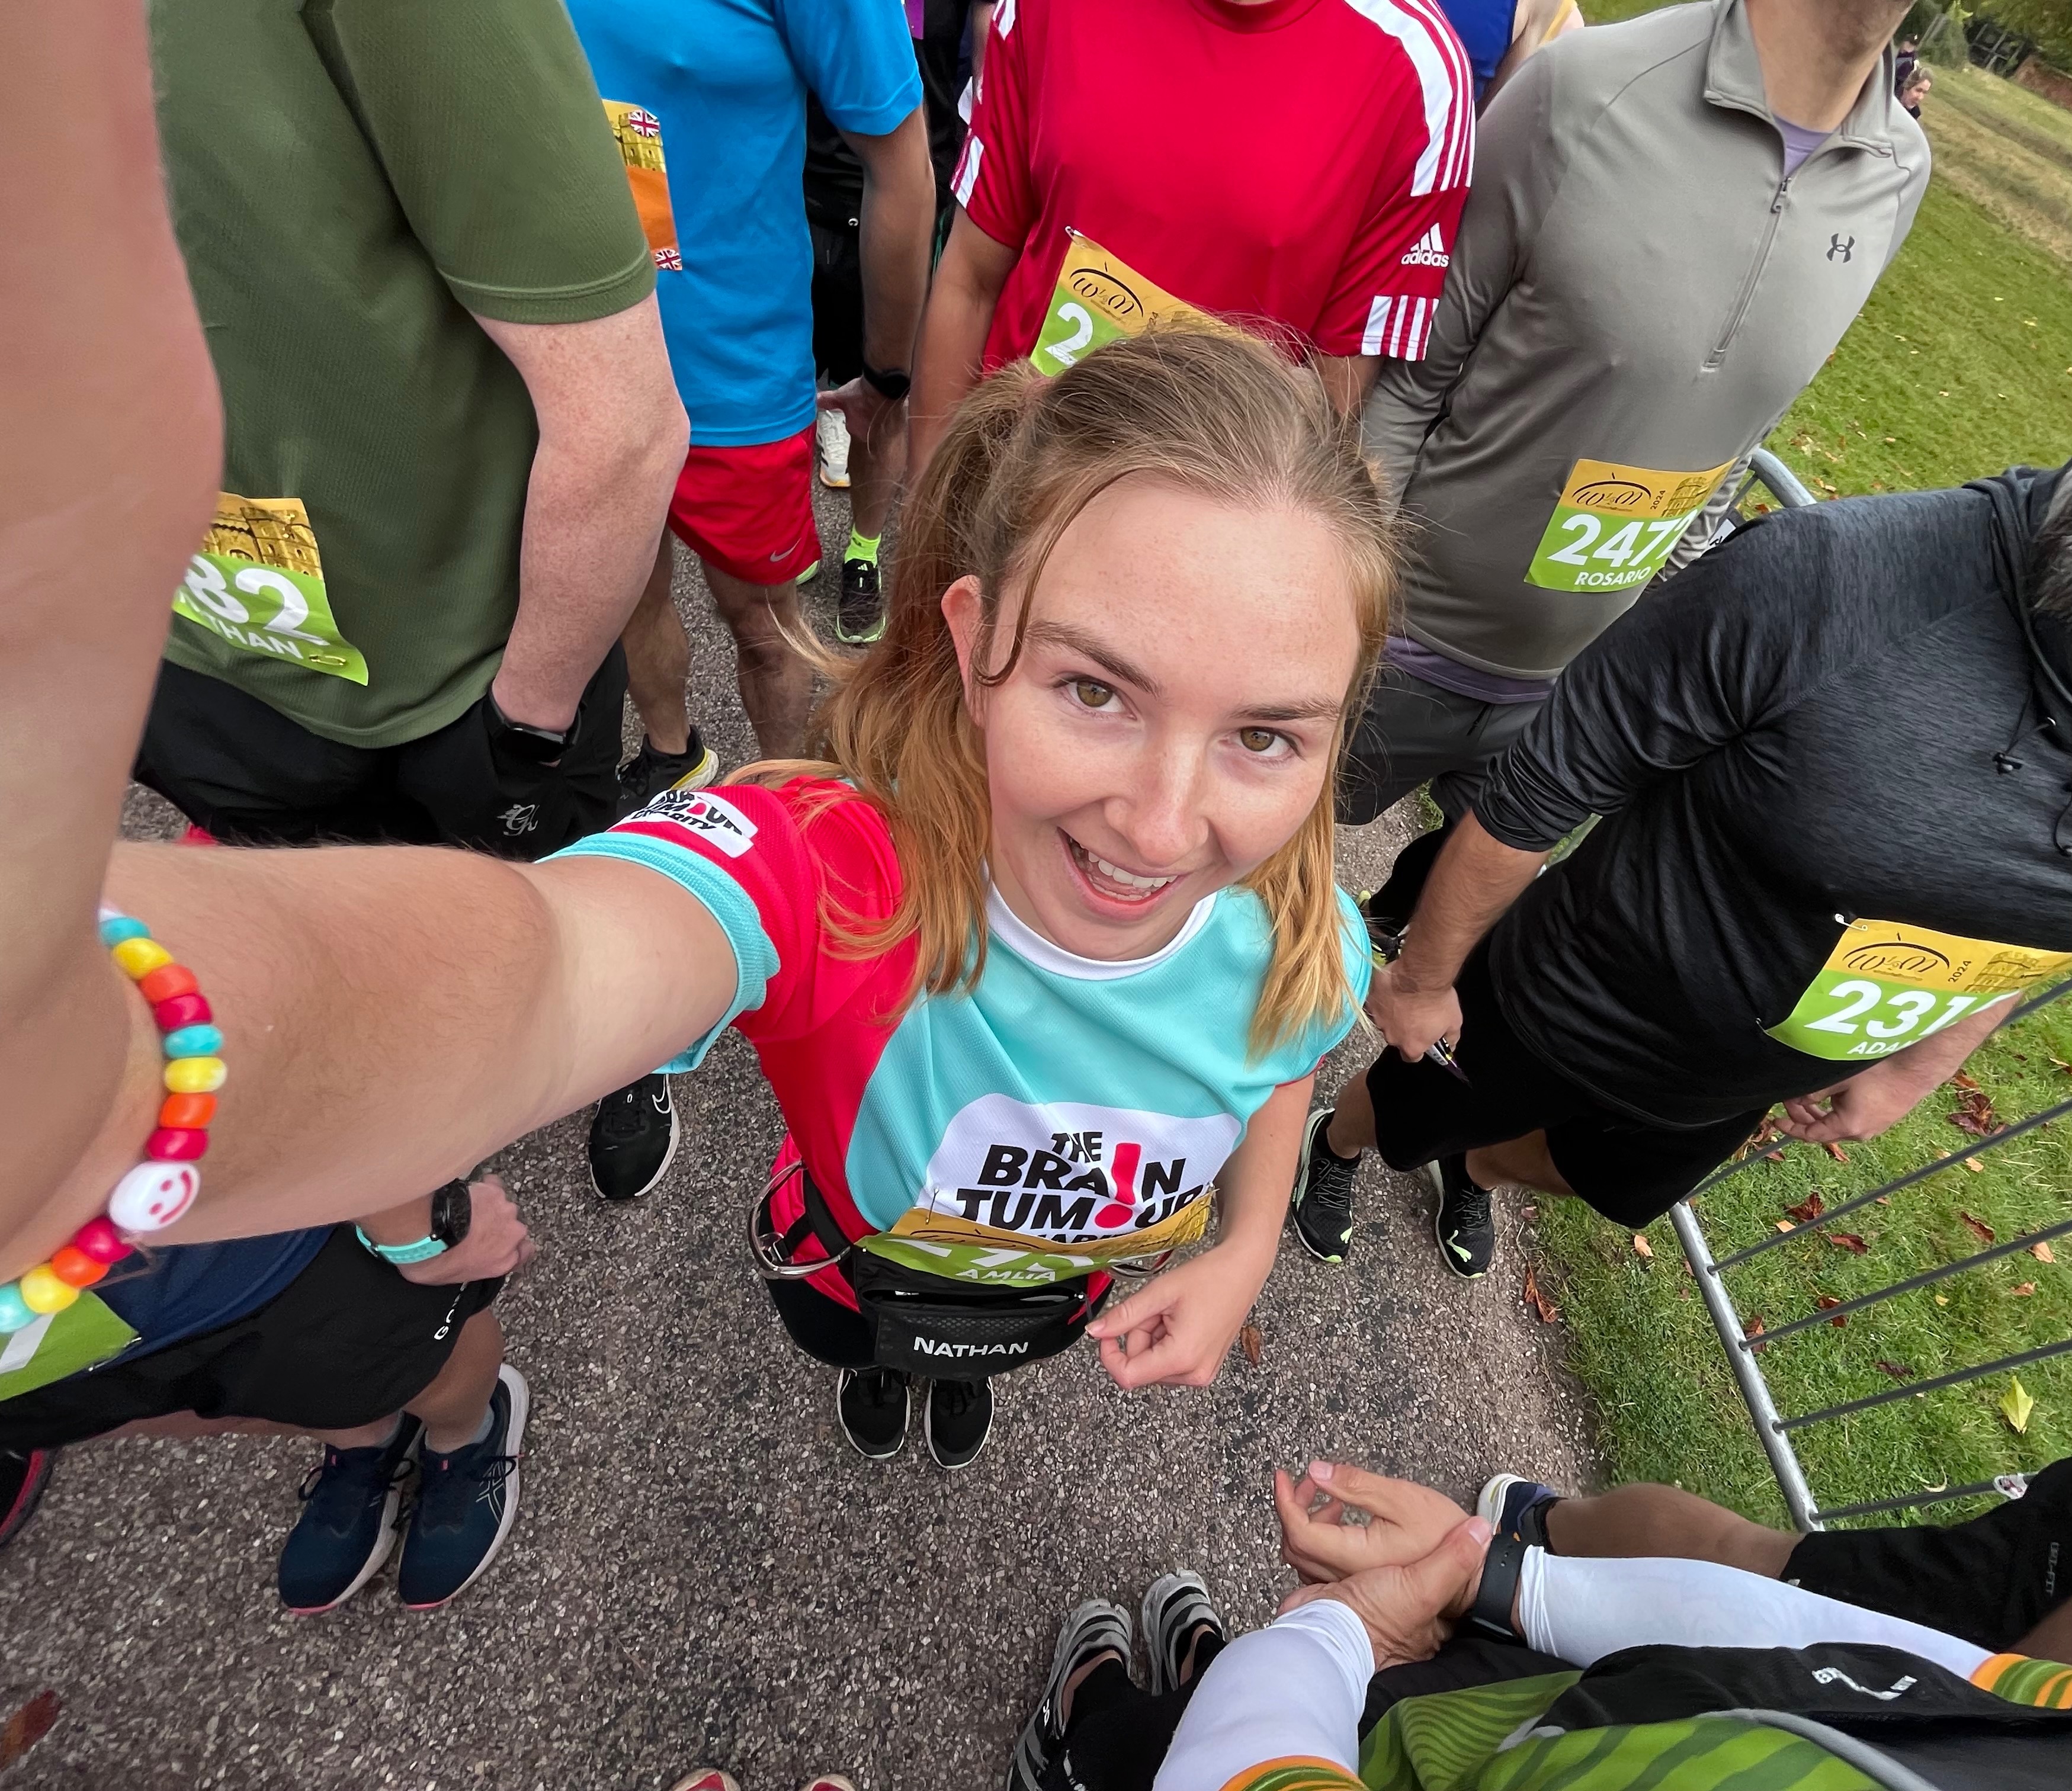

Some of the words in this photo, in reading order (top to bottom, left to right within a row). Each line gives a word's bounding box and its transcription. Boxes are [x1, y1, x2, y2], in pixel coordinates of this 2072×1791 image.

[1401, 249, 1450, 268] adidas
[1650, 490, 1666, 510] 2024
[1574, 566, 1652, 586] ROSARIO
[1947, 959, 1972, 983] 2024
[1050, 1131, 1103, 1163] THE
[913, 1336, 1029, 1358] NATHAN
